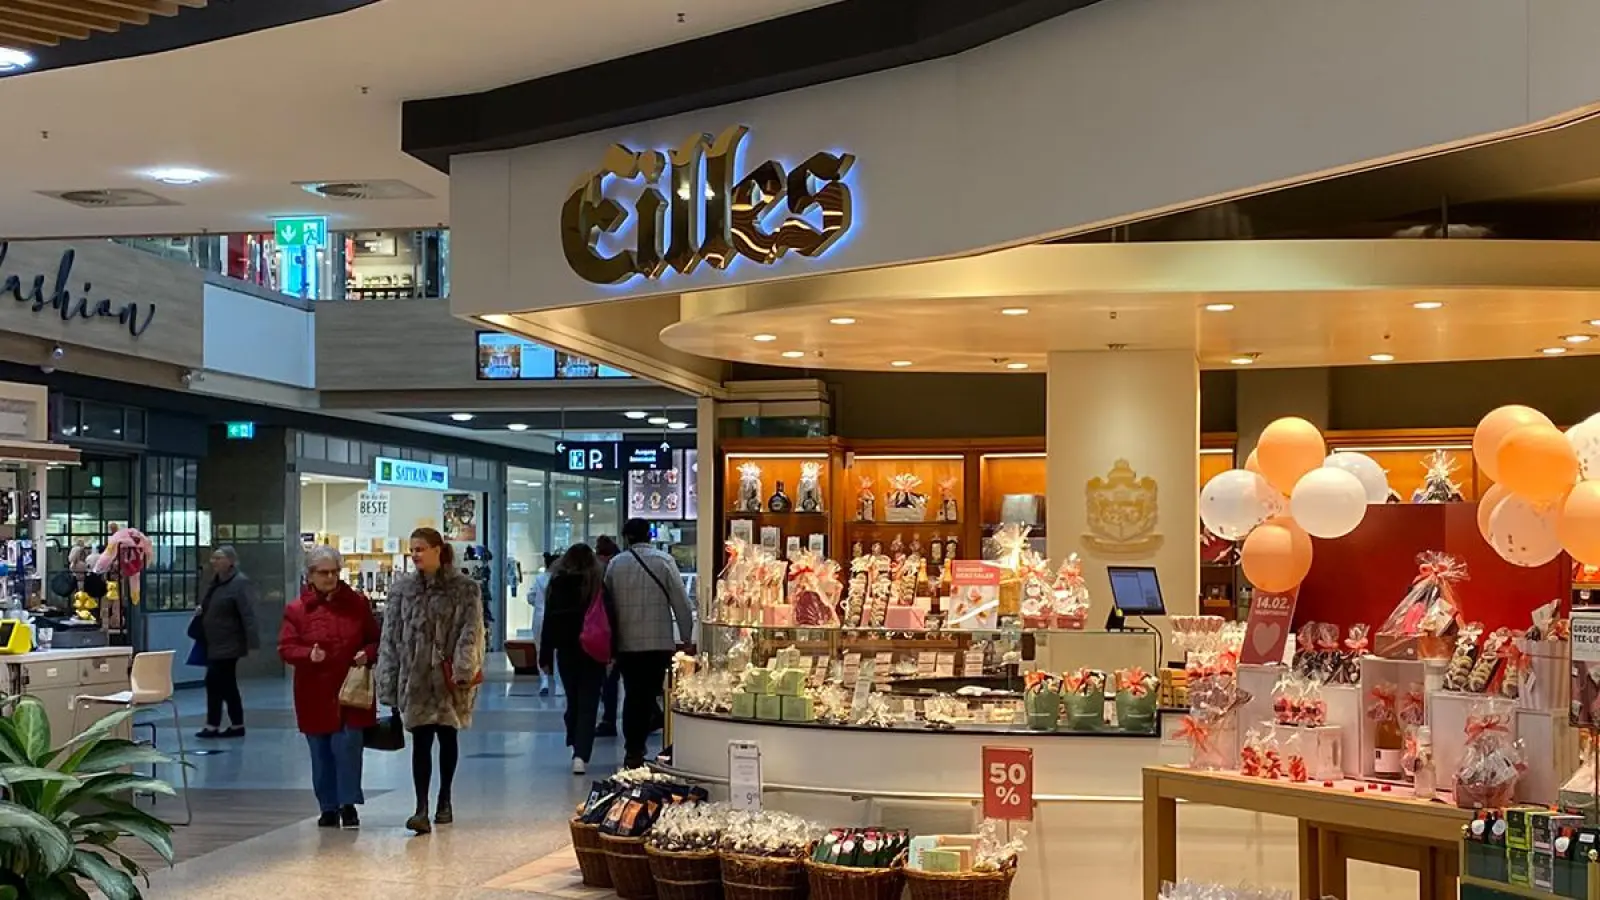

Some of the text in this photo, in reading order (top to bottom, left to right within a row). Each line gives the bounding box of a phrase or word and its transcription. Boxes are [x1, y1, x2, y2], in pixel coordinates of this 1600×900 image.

[560, 125, 856, 285] Eilles
[360, 501, 387, 514] BESTE
[1256, 596, 1290, 609] 14.02.
[990, 762, 1026, 785] 50
[995, 786, 1021, 806] %
